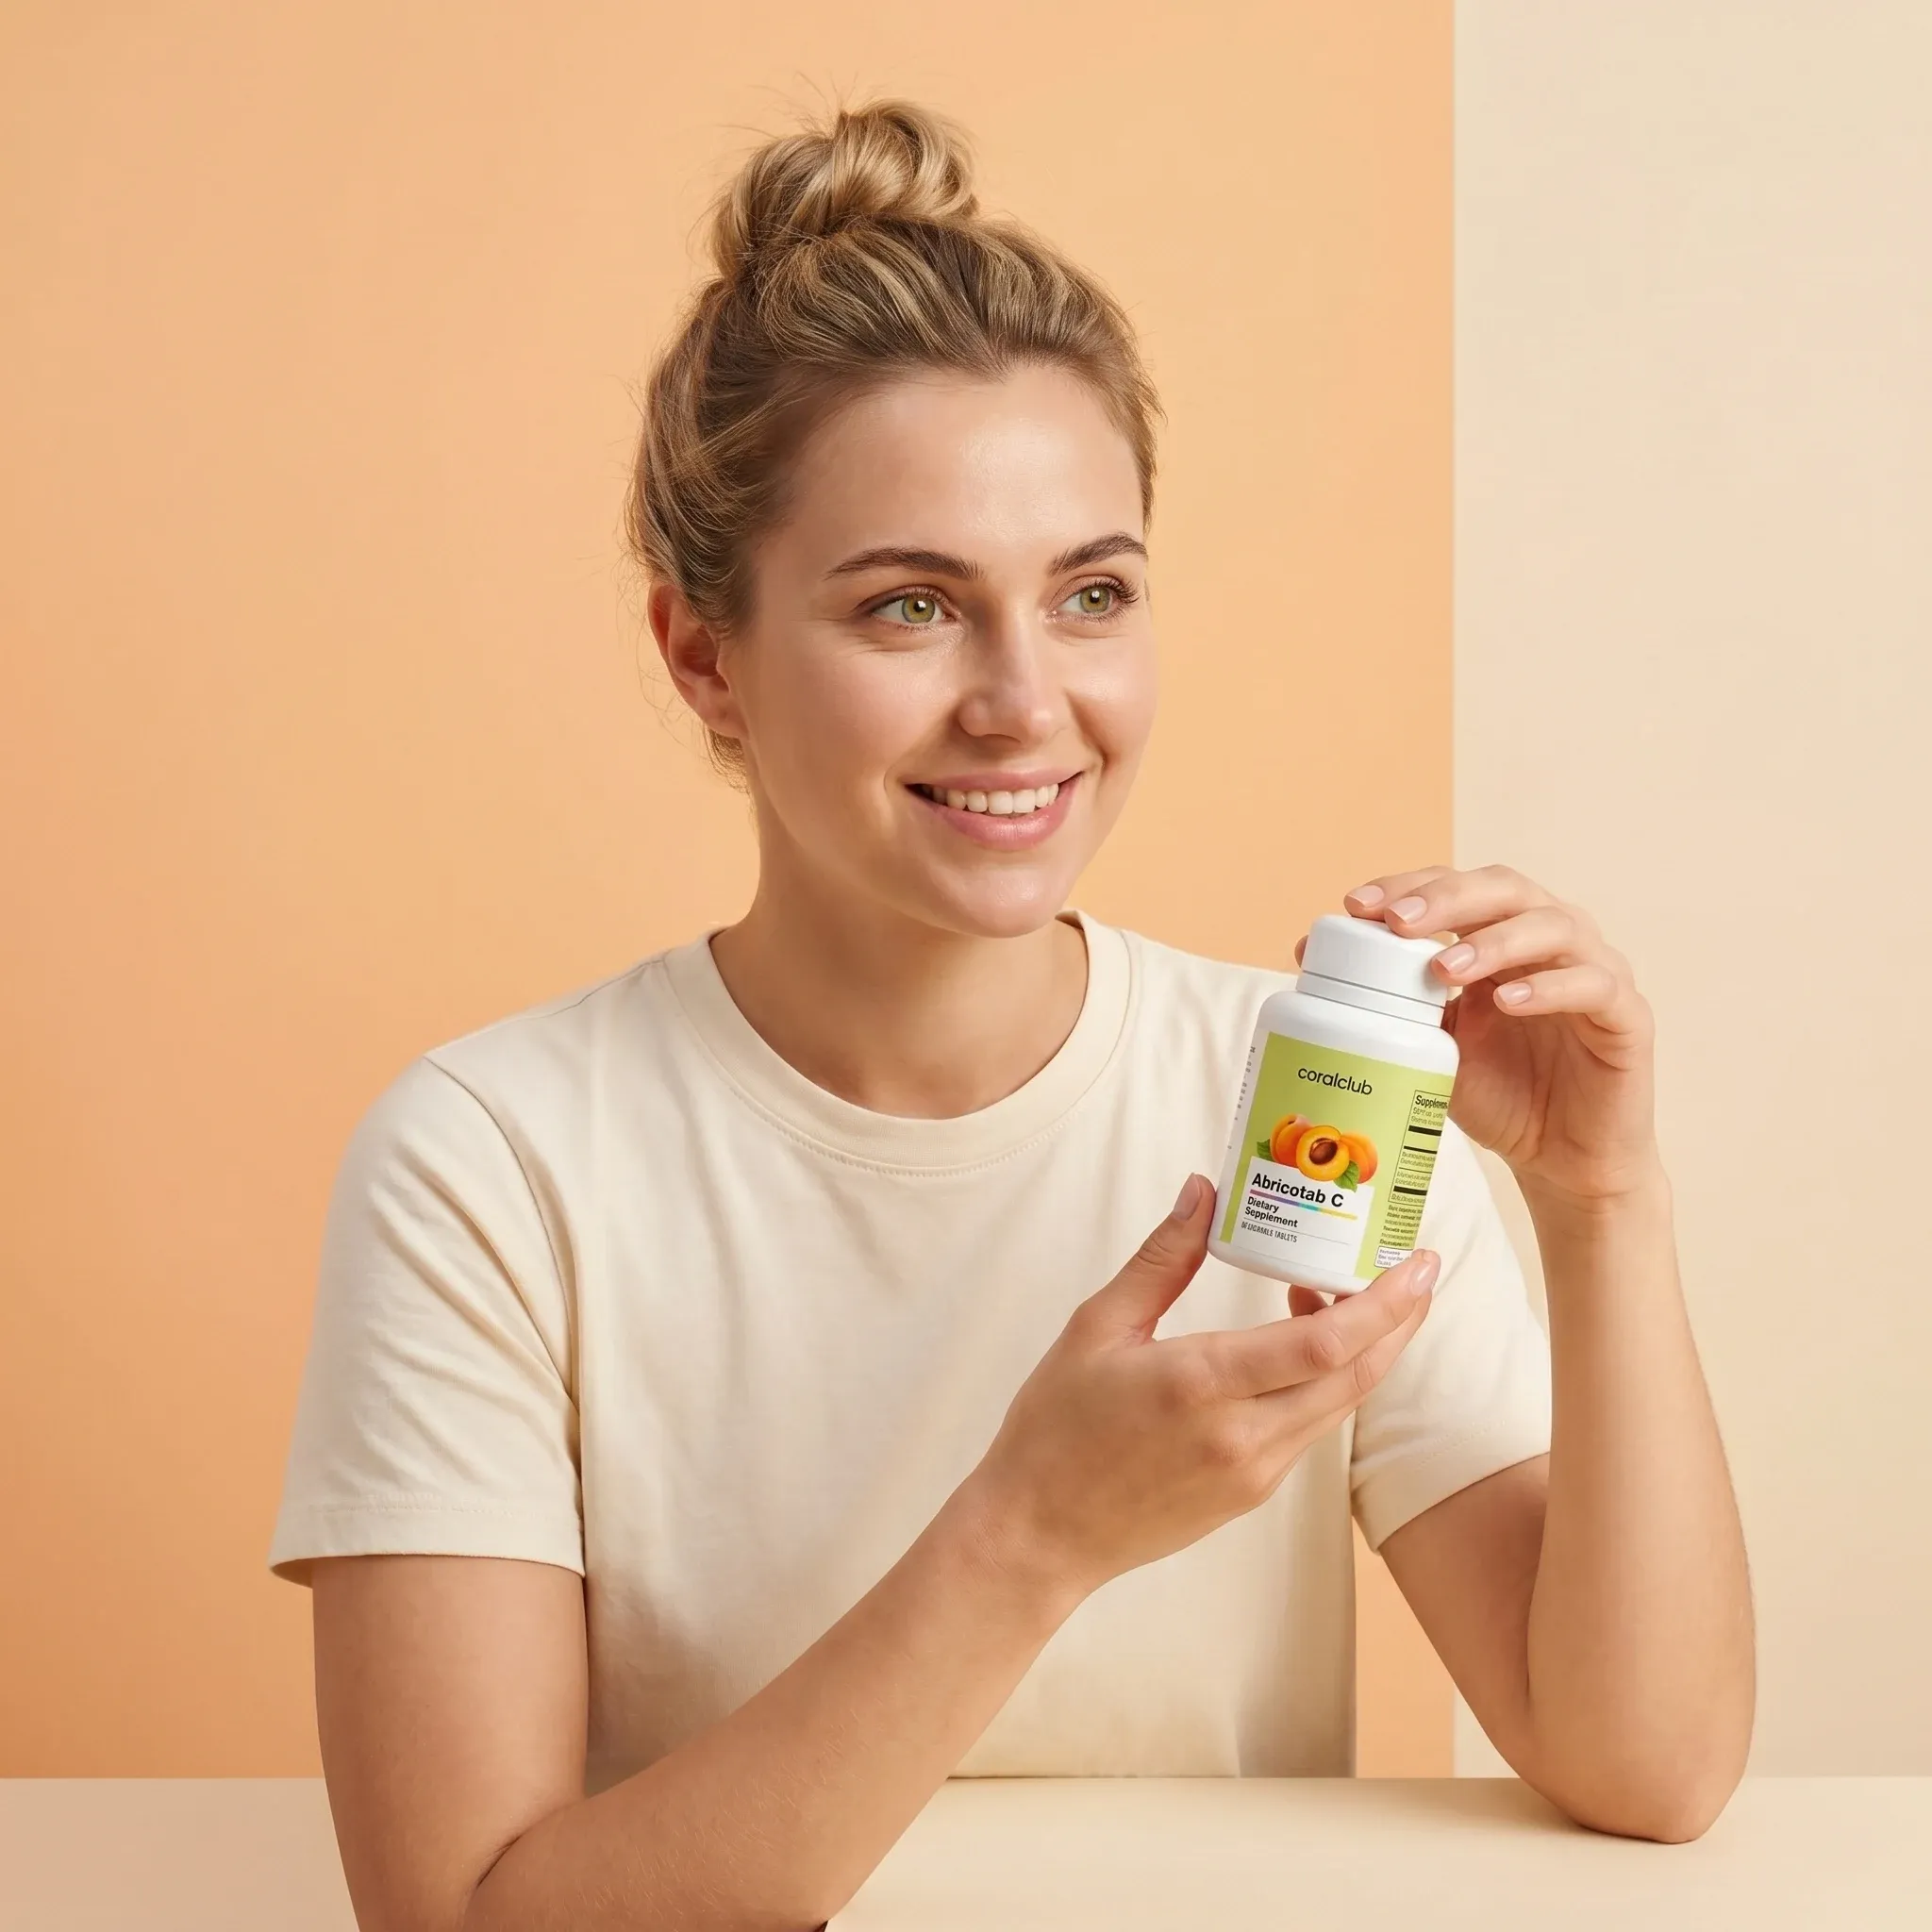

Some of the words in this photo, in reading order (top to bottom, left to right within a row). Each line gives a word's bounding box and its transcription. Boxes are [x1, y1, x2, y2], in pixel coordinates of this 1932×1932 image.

[1298, 1067, 1373, 1095] coralclub
[1247, 1196, 1279, 1213] Dietary
[1252, 1173, 1326, 1204] Abricotab
[1331, 1193, 1344, 1208] C
